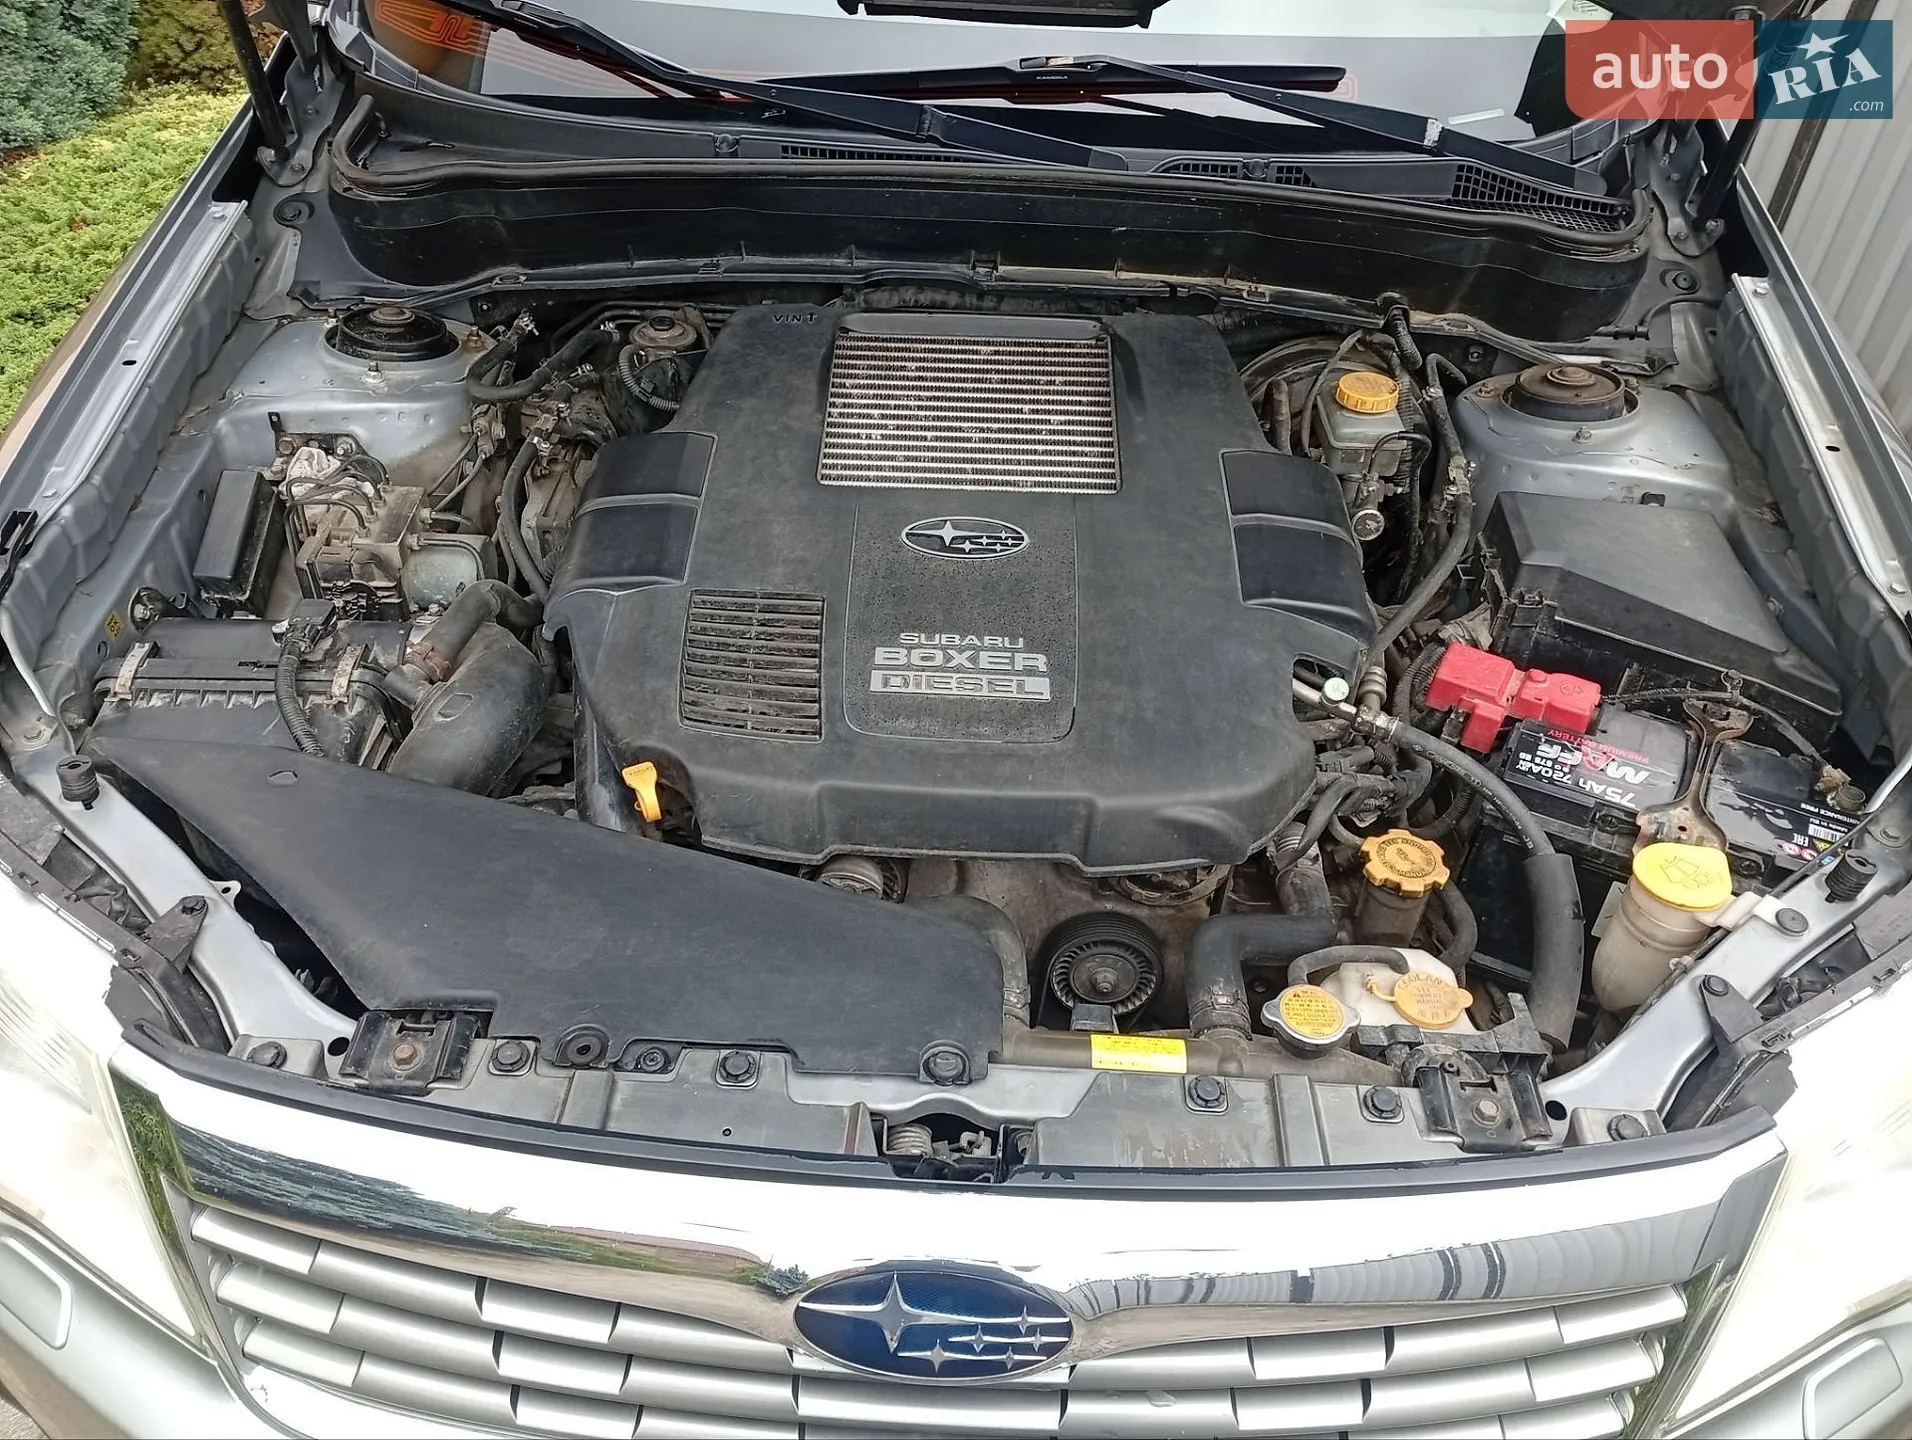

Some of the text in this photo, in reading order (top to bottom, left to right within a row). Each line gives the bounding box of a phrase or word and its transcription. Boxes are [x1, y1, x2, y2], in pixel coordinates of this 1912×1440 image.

[899, 632, 1024, 649] SUBARU
[874, 646, 1048, 672] BOXER
[881, 672, 1045, 697] DIESEL
[1819, 808, 1861, 825] AINTENANCE
